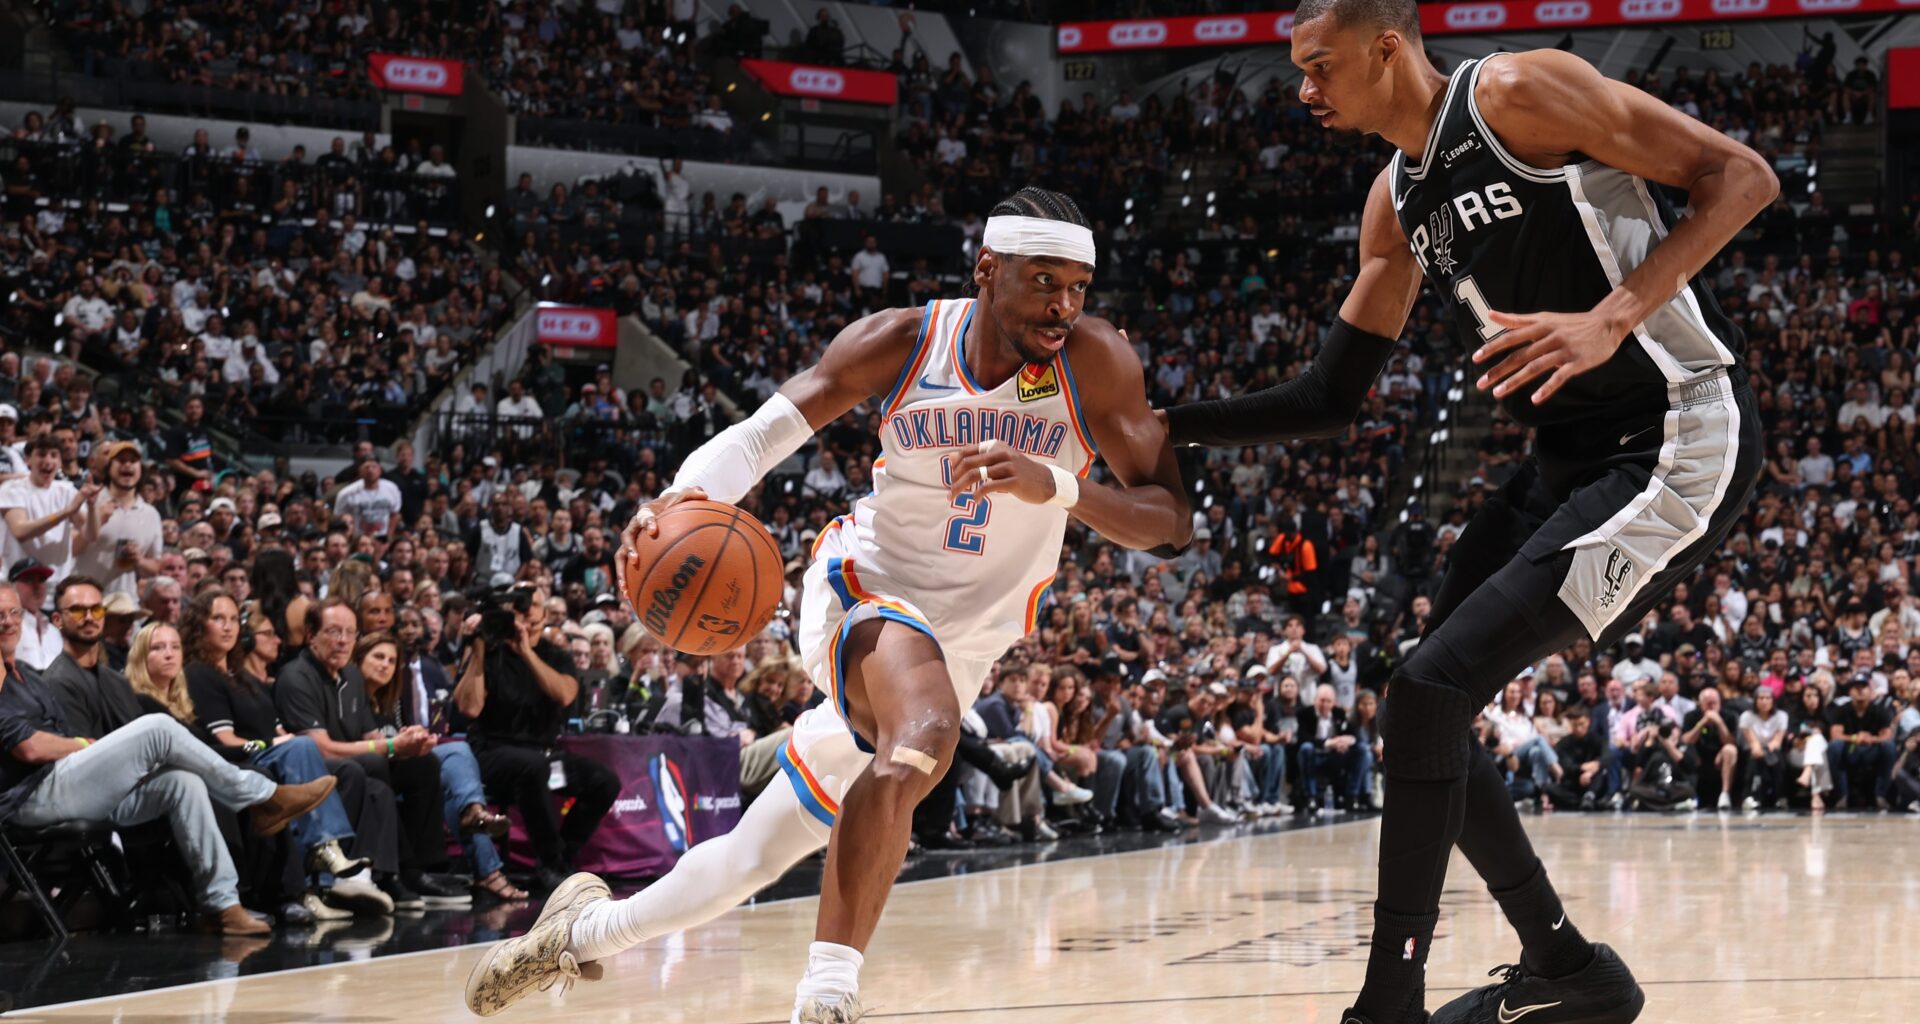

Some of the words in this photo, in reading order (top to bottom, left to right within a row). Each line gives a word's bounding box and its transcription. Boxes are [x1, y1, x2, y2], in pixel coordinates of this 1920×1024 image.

[1703, 31, 1732, 49] 128
[1066, 63, 1095, 79] 127
[1445, 139, 1475, 162] LEDGER
[1454, 274, 1509, 343] 1
[890, 407, 1068, 459] OKLAHOMA
[942, 490, 992, 556] 2
[645, 554, 706, 637] Wilson
